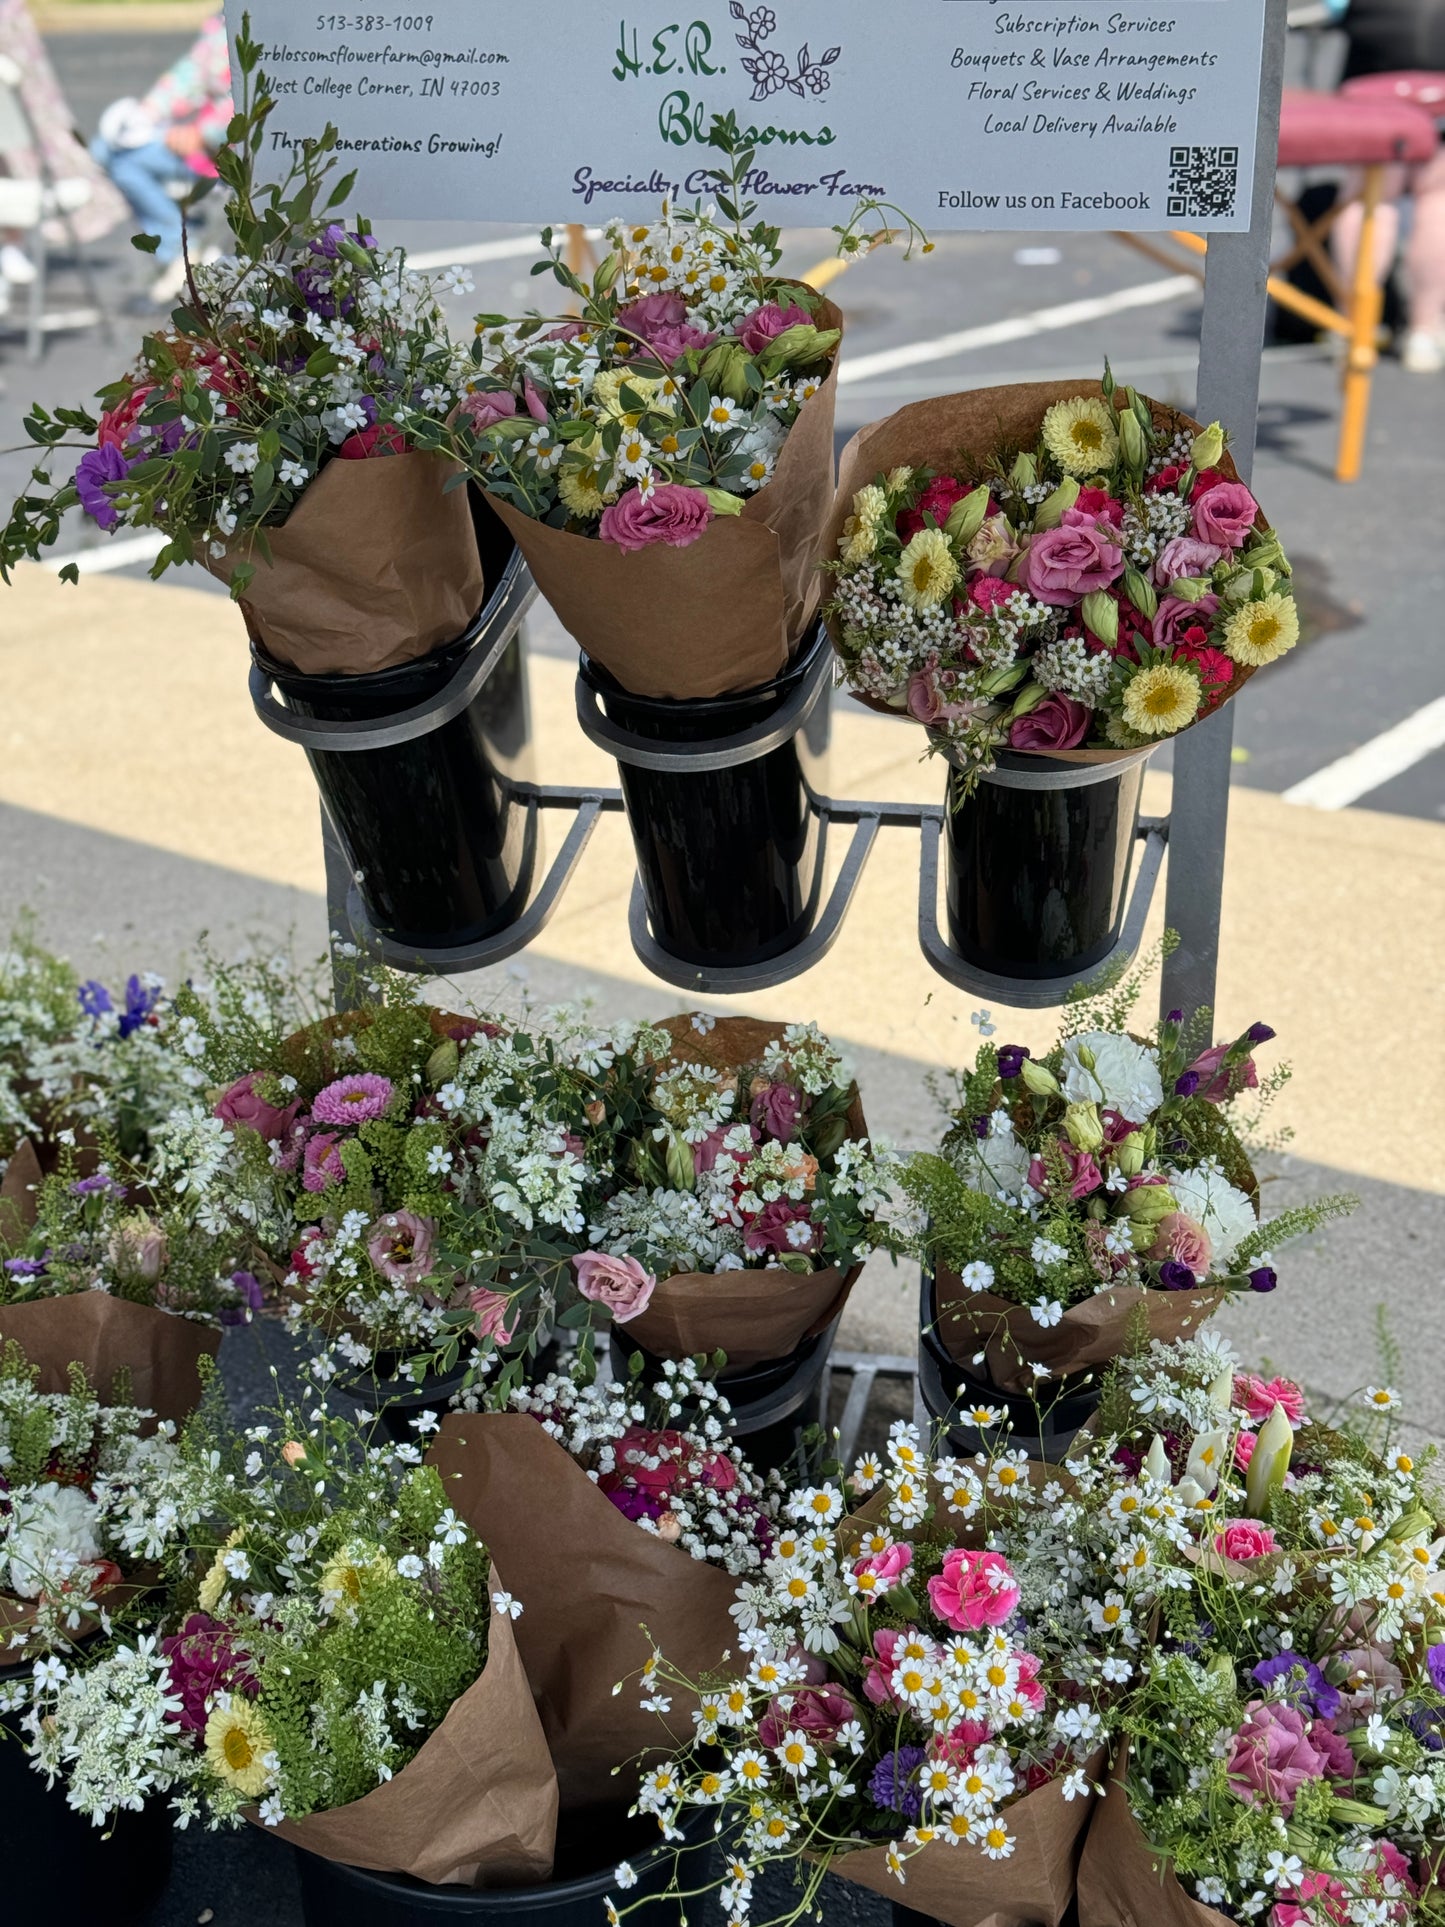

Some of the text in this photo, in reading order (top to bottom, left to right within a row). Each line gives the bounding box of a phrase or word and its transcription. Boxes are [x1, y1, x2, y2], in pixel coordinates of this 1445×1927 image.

[316, 15, 434, 32] 513-383-1009
[994, 13, 1177, 37] Subscription Services
[250, 44, 510, 66] erblossomsflowerfarm@gmail.com
[950, 48, 1218, 73] Bouquets & Vase Arrangements
[303, 77, 353, 99] College
[357, 77, 414, 97] Corner,
[419, 77, 445, 97] IN
[450, 80, 501, 97] 47003
[967, 80, 1197, 105] Floral Services & Weddings
[658, 90, 837, 147] Blssoms
[984, 114, 1178, 138] Local Delivery Available
[321, 132, 423, 153] enerations
[427, 133, 503, 159] Growing!
[819, 170, 887, 197] Farm
[938, 191, 1150, 210] Follow us on Facebook
